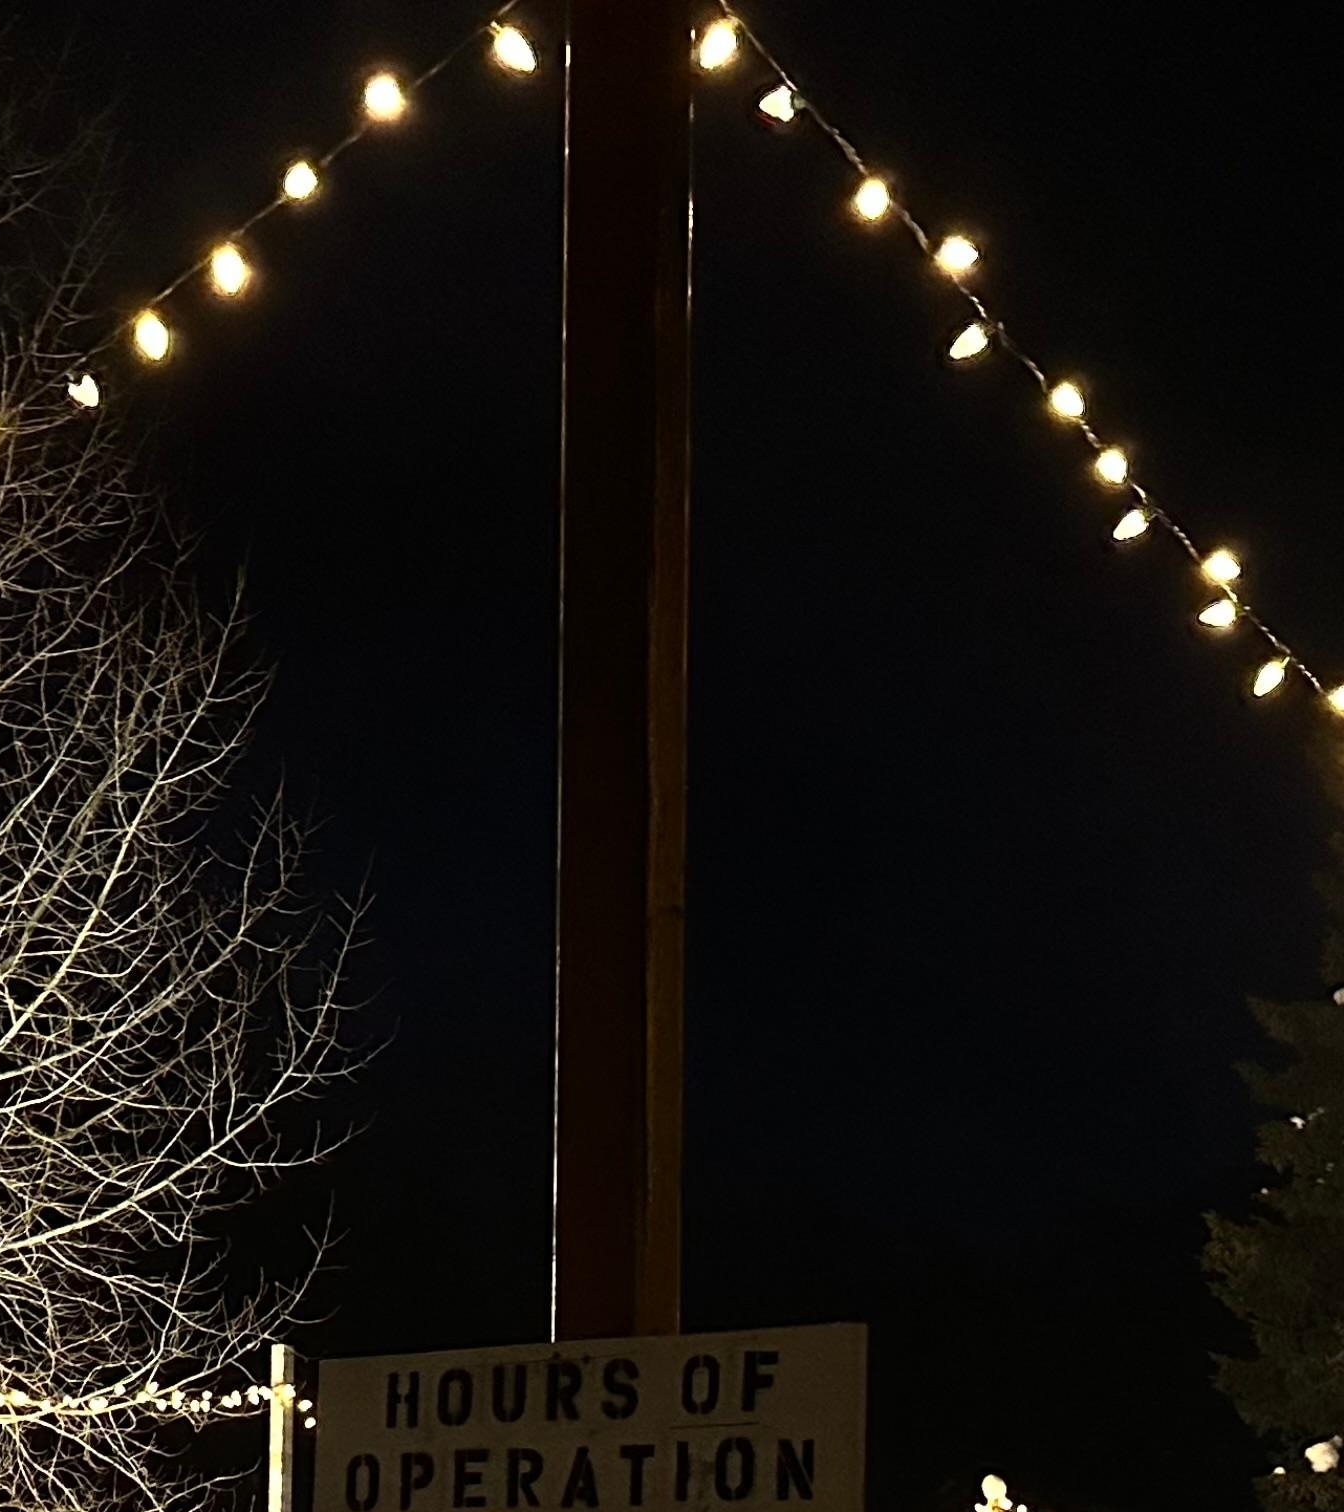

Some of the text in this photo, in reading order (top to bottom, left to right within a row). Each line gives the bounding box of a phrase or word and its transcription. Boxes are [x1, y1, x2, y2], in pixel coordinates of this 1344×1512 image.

[386, 1350, 779, 1429] HOURS OF
[345, 1437, 815, 1512] OPERATION
